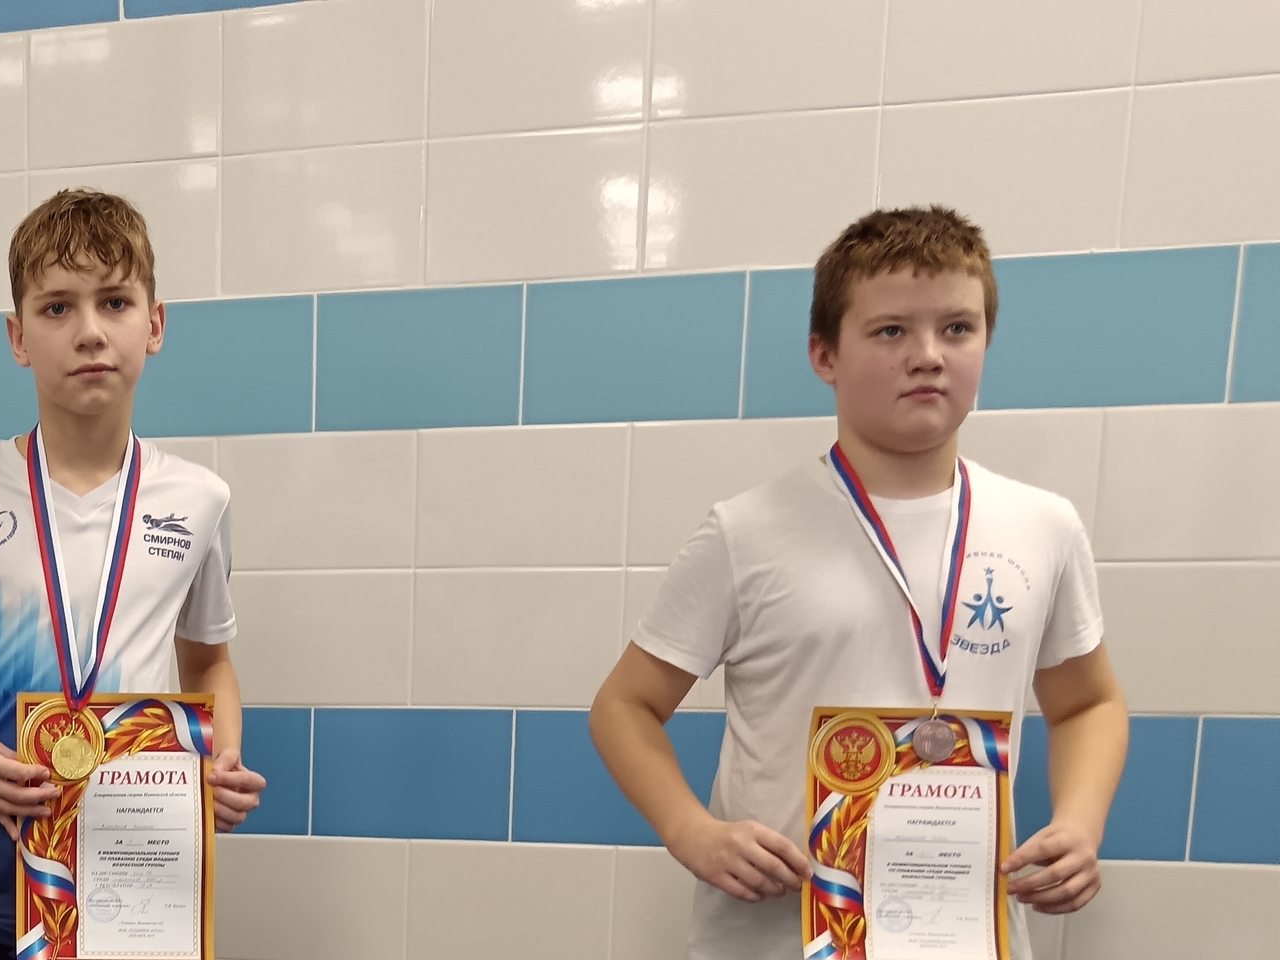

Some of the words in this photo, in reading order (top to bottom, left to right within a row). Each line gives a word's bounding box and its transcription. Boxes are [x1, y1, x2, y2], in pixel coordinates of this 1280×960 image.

[143, 533, 191, 550] СМИРНОВ
[148, 546, 185, 562] СТЕПАН
[950, 634, 1011, 655] ЗВЕЗДА
[98, 770, 188, 785] ГРАМОТА
[888, 783, 983, 799] ГРАМОТА
